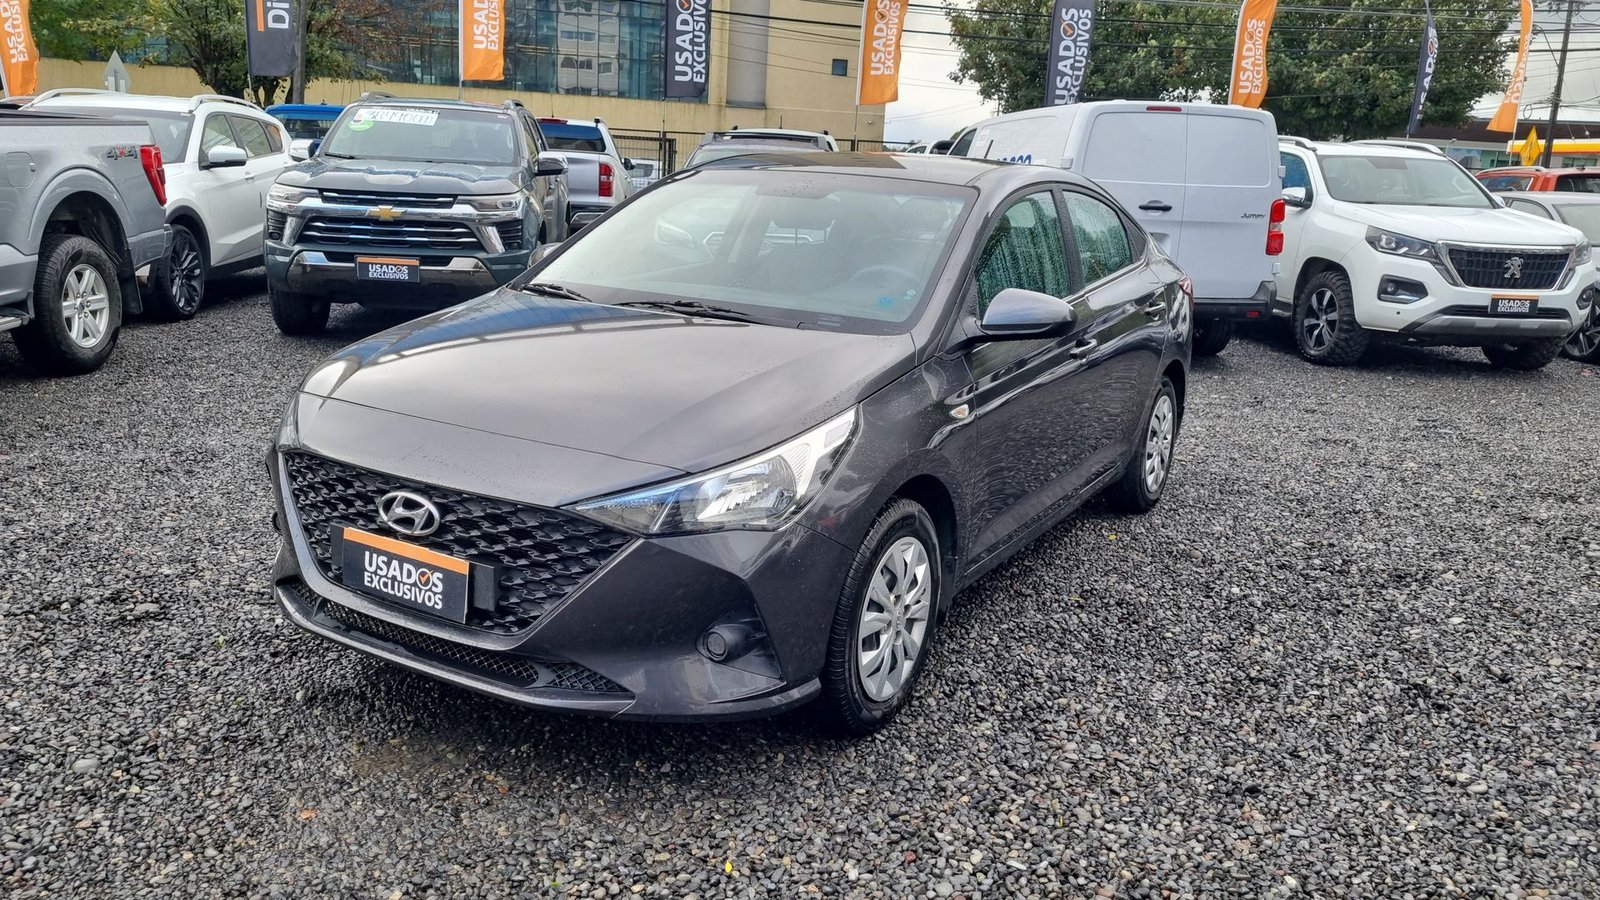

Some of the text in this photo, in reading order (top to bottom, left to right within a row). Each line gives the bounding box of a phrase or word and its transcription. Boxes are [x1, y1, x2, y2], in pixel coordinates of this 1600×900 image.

[870, 0, 891, 75] USADOS
[883, 1, 901, 75] EXCLUSIVOS
[1054, 7, 1079, 105] USADOS
[1238, 18, 1258, 94] USADOS
[1250, 20, 1267, 95] EXCLUSIVOS
[368, 263, 409, 274] USADOS
[368, 271, 409, 280] EXCLUSIVOS
[1498, 299, 1531, 308] USADOS
[364, 551, 443, 593] USADOS
[364, 571, 443, 610] EXCLUSIVOS
